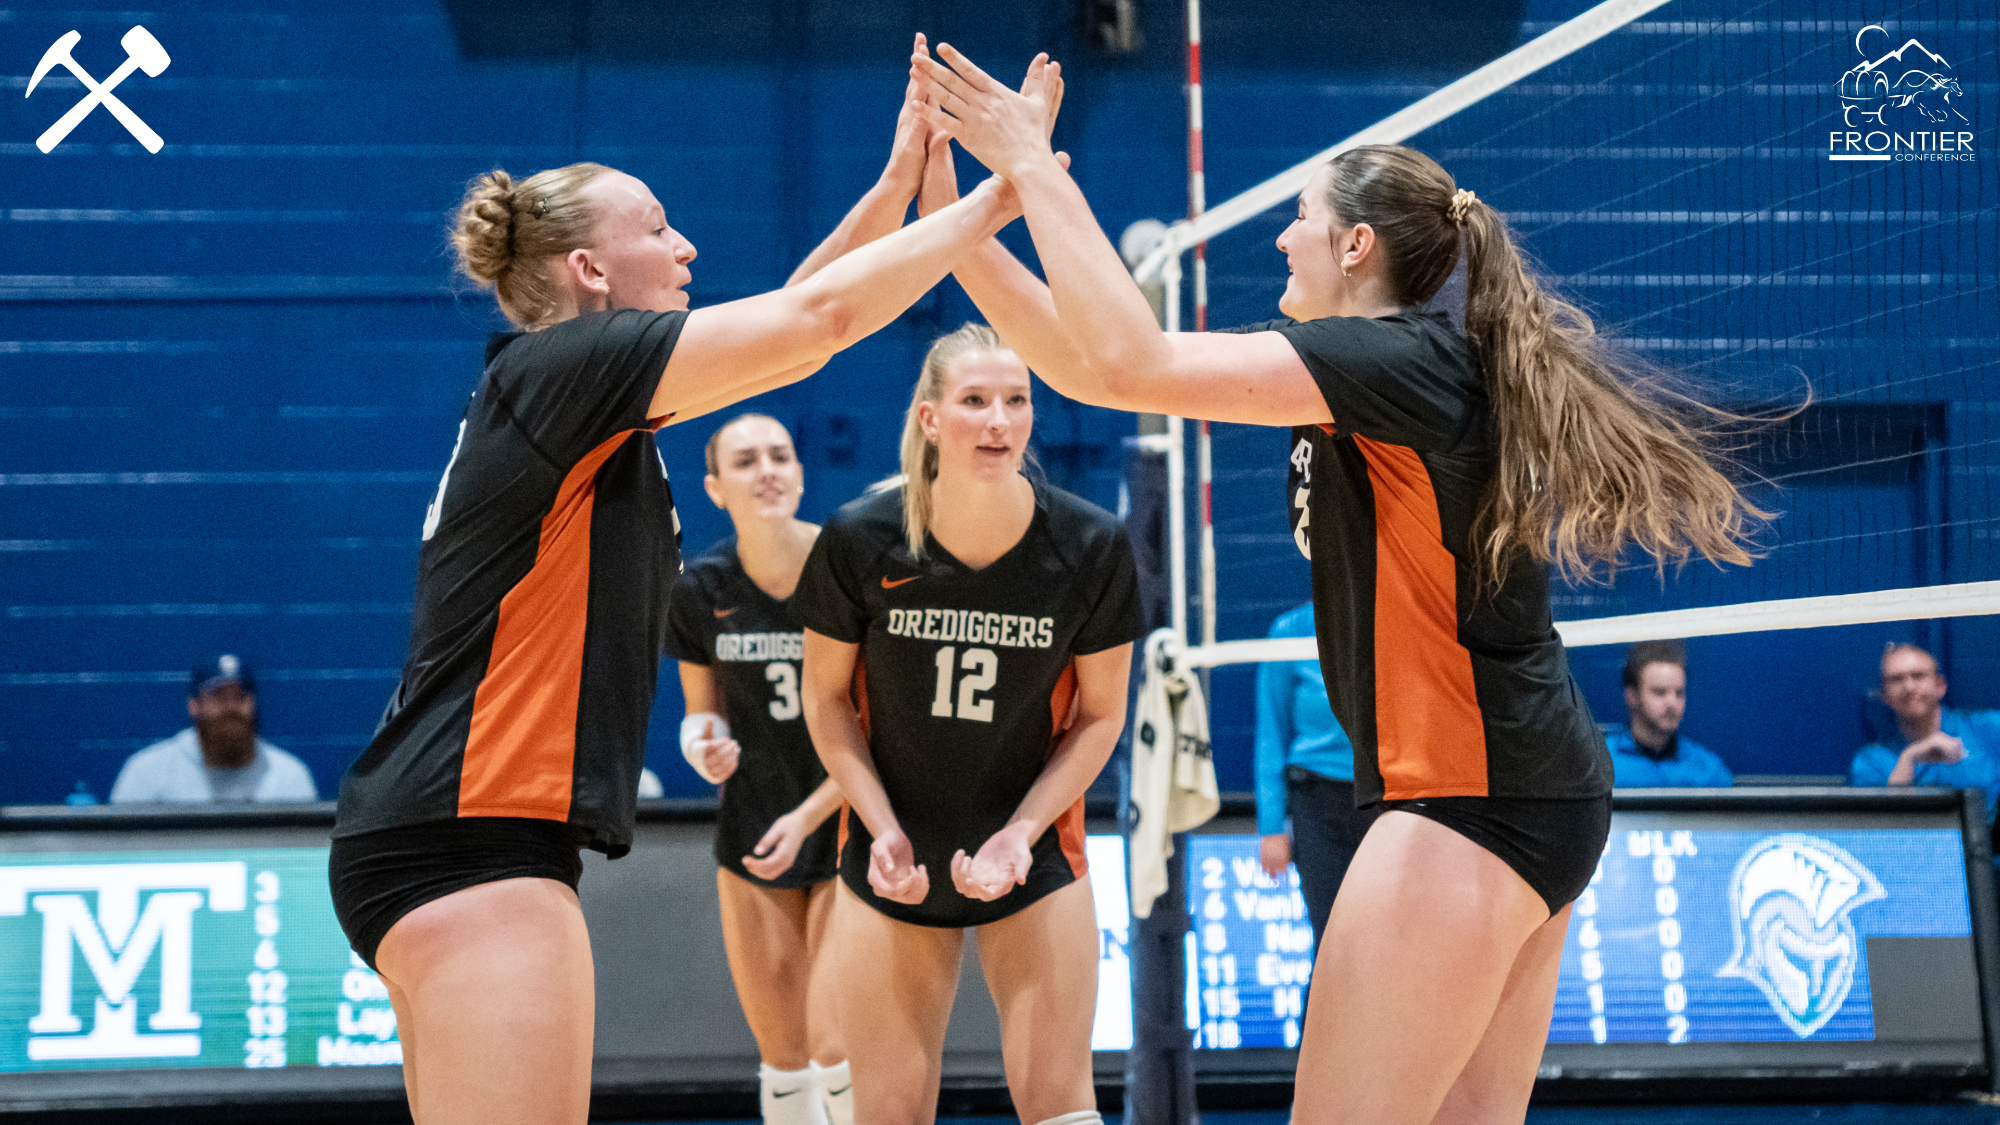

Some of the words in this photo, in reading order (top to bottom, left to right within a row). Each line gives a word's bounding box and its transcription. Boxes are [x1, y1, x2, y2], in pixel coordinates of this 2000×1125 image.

[888, 608, 1054, 649] OREDIGGERS
[765, 661, 801, 721] 3
[931, 646, 999, 723] 12
[1203, 857, 1225, 889] 2
[1652, 855, 1676, 884] 0
[1204, 889, 1226, 921] 6
[1655, 885, 1679, 916] 0
[1657, 917, 1682, 948] 0
[1203, 955, 1238, 986] 11
[1661, 949, 1685, 981] 0
[248, 970, 288, 1004] 12
[1203, 986, 1240, 1018] 15
[1586, 982, 1604, 1014] 1
[1663, 982, 1688, 1013] 0
[1589, 1014, 1607, 1045] 1
[1666, 1014, 1690, 1045] 2
